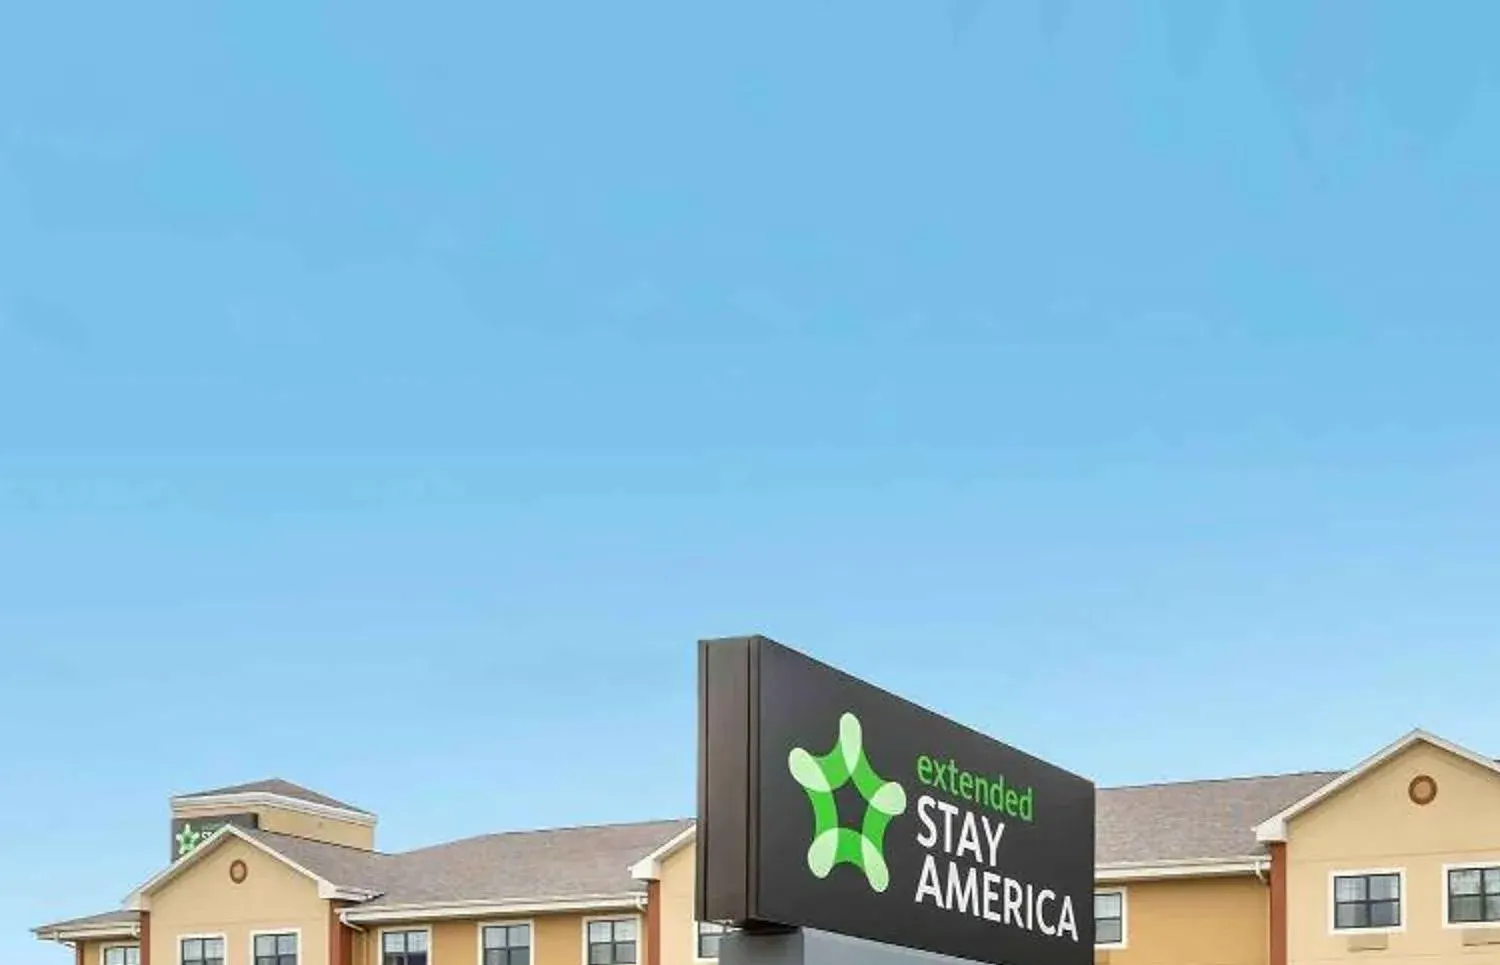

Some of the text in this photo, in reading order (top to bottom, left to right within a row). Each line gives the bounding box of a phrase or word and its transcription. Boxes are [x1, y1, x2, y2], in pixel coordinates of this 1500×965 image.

[917, 755, 1033, 821] extended
[917, 795, 1005, 866] STAY
[915, 854, 1079, 942] AMERICA
